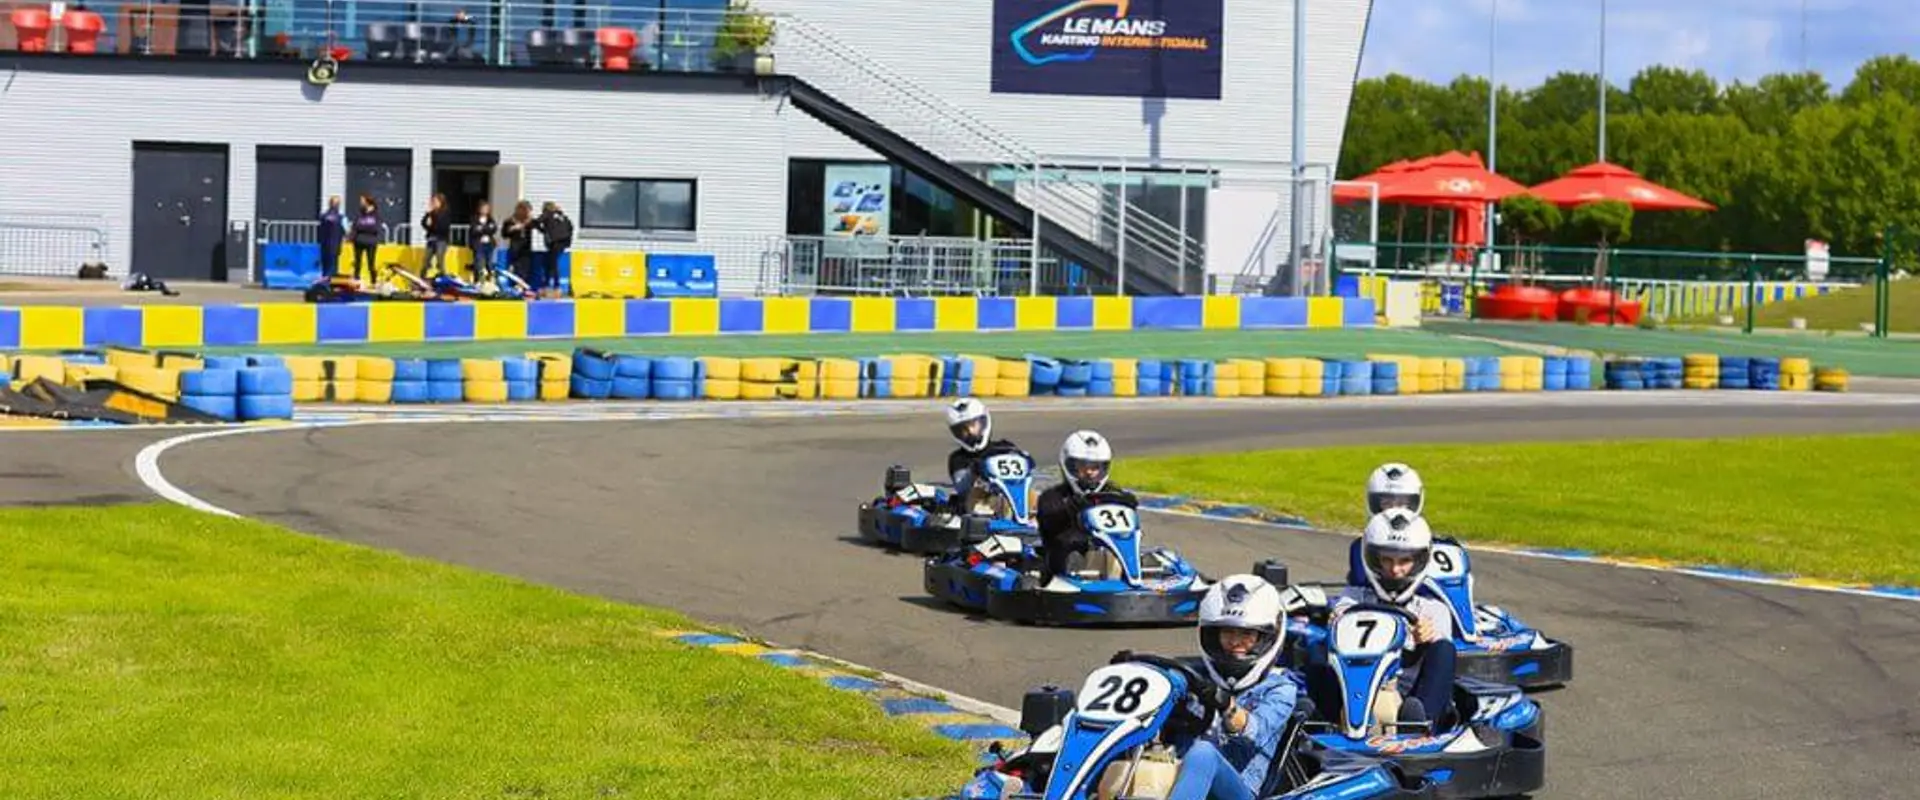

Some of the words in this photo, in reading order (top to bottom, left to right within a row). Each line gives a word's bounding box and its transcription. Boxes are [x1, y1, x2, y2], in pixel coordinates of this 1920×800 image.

[1063, 17, 1088, 33] LE
[1090, 18, 1167, 35] MANS
[1041, 34, 1099, 46] KARTING
[996, 459, 1024, 476] 53
[1099, 510, 1131, 528] 31
[1433, 549, 1453, 573] 9
[1355, 619, 1378, 648] 7
[1084, 674, 1149, 714] 28
